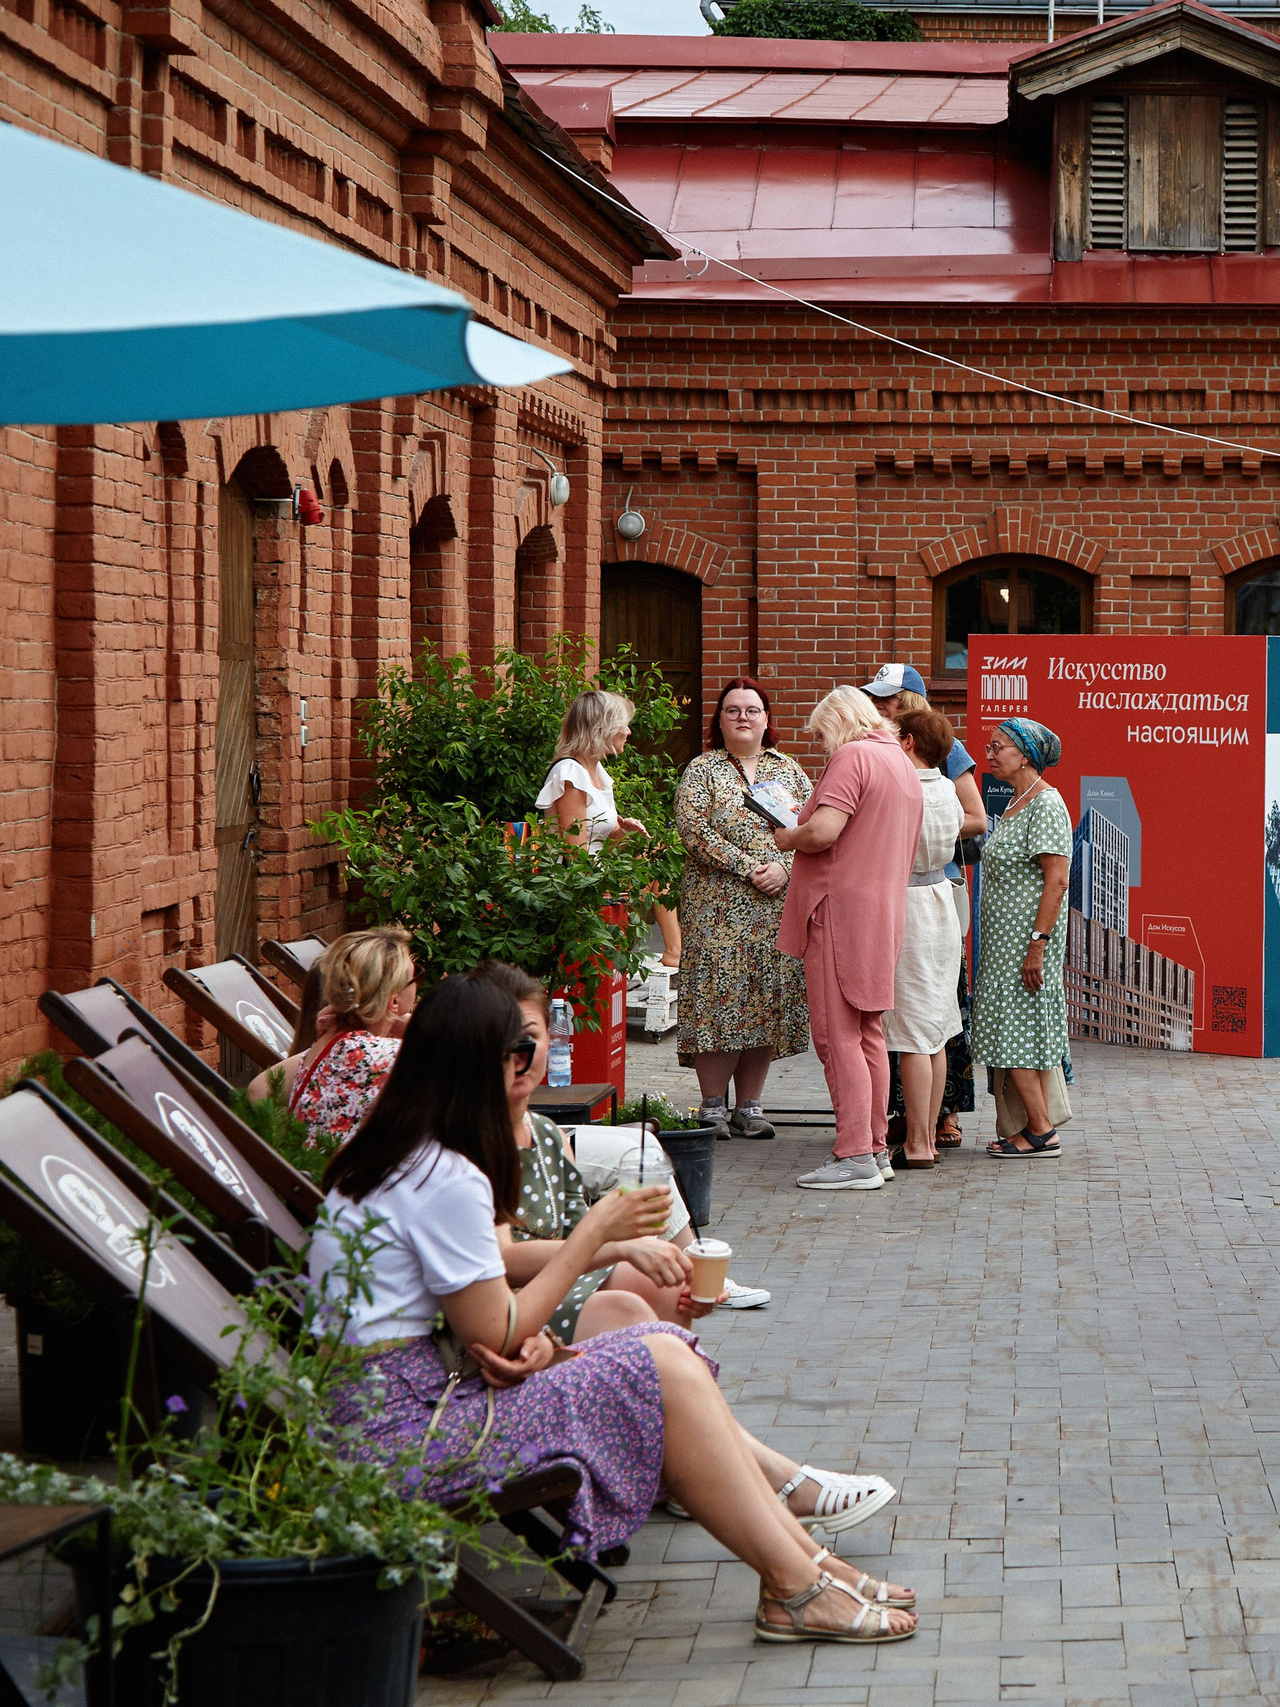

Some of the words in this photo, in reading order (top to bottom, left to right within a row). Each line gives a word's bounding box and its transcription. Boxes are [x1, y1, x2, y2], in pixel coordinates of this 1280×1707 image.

[981, 656, 1028, 670] ЗИМ
[1047, 657, 1167, 686] Искусство
[980, 704, 1028, 713] ГАЛЕРЕЯ
[1078, 691, 1250, 713] наслаждаться
[1127, 724, 1250, 747] настоящим
[1087, 789, 1099, 797] Дом
